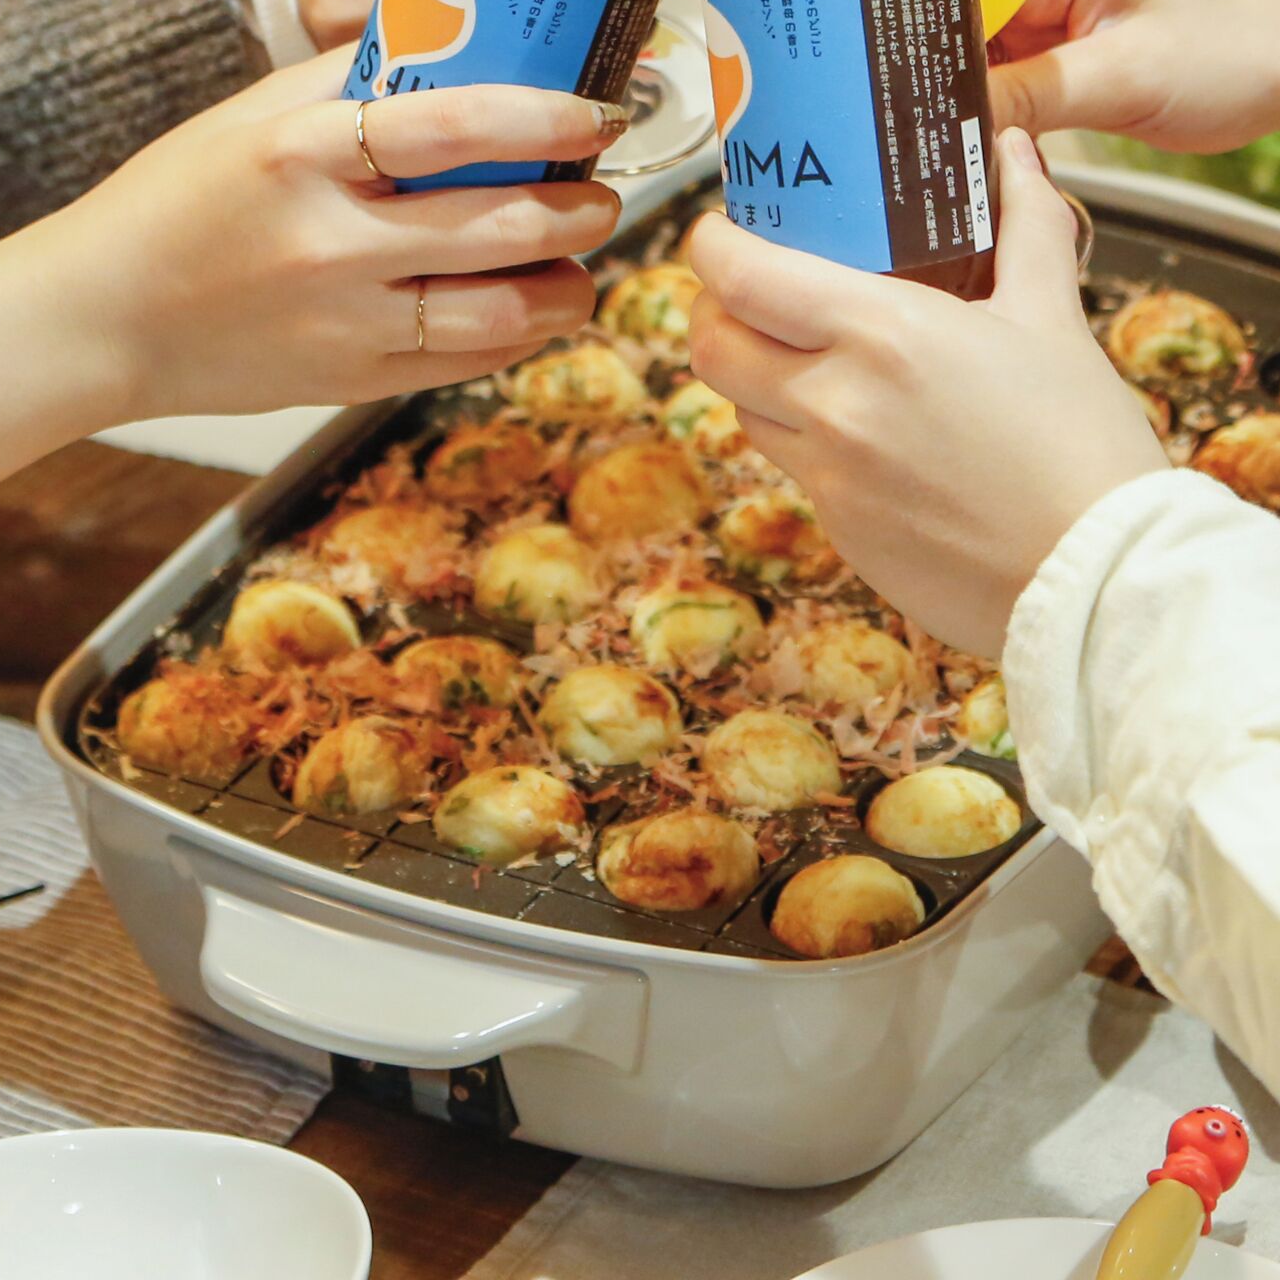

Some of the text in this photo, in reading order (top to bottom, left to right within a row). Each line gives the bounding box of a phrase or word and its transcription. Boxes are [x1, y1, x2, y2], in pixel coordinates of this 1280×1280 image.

[932, 54, 947, 113] アルコール分
